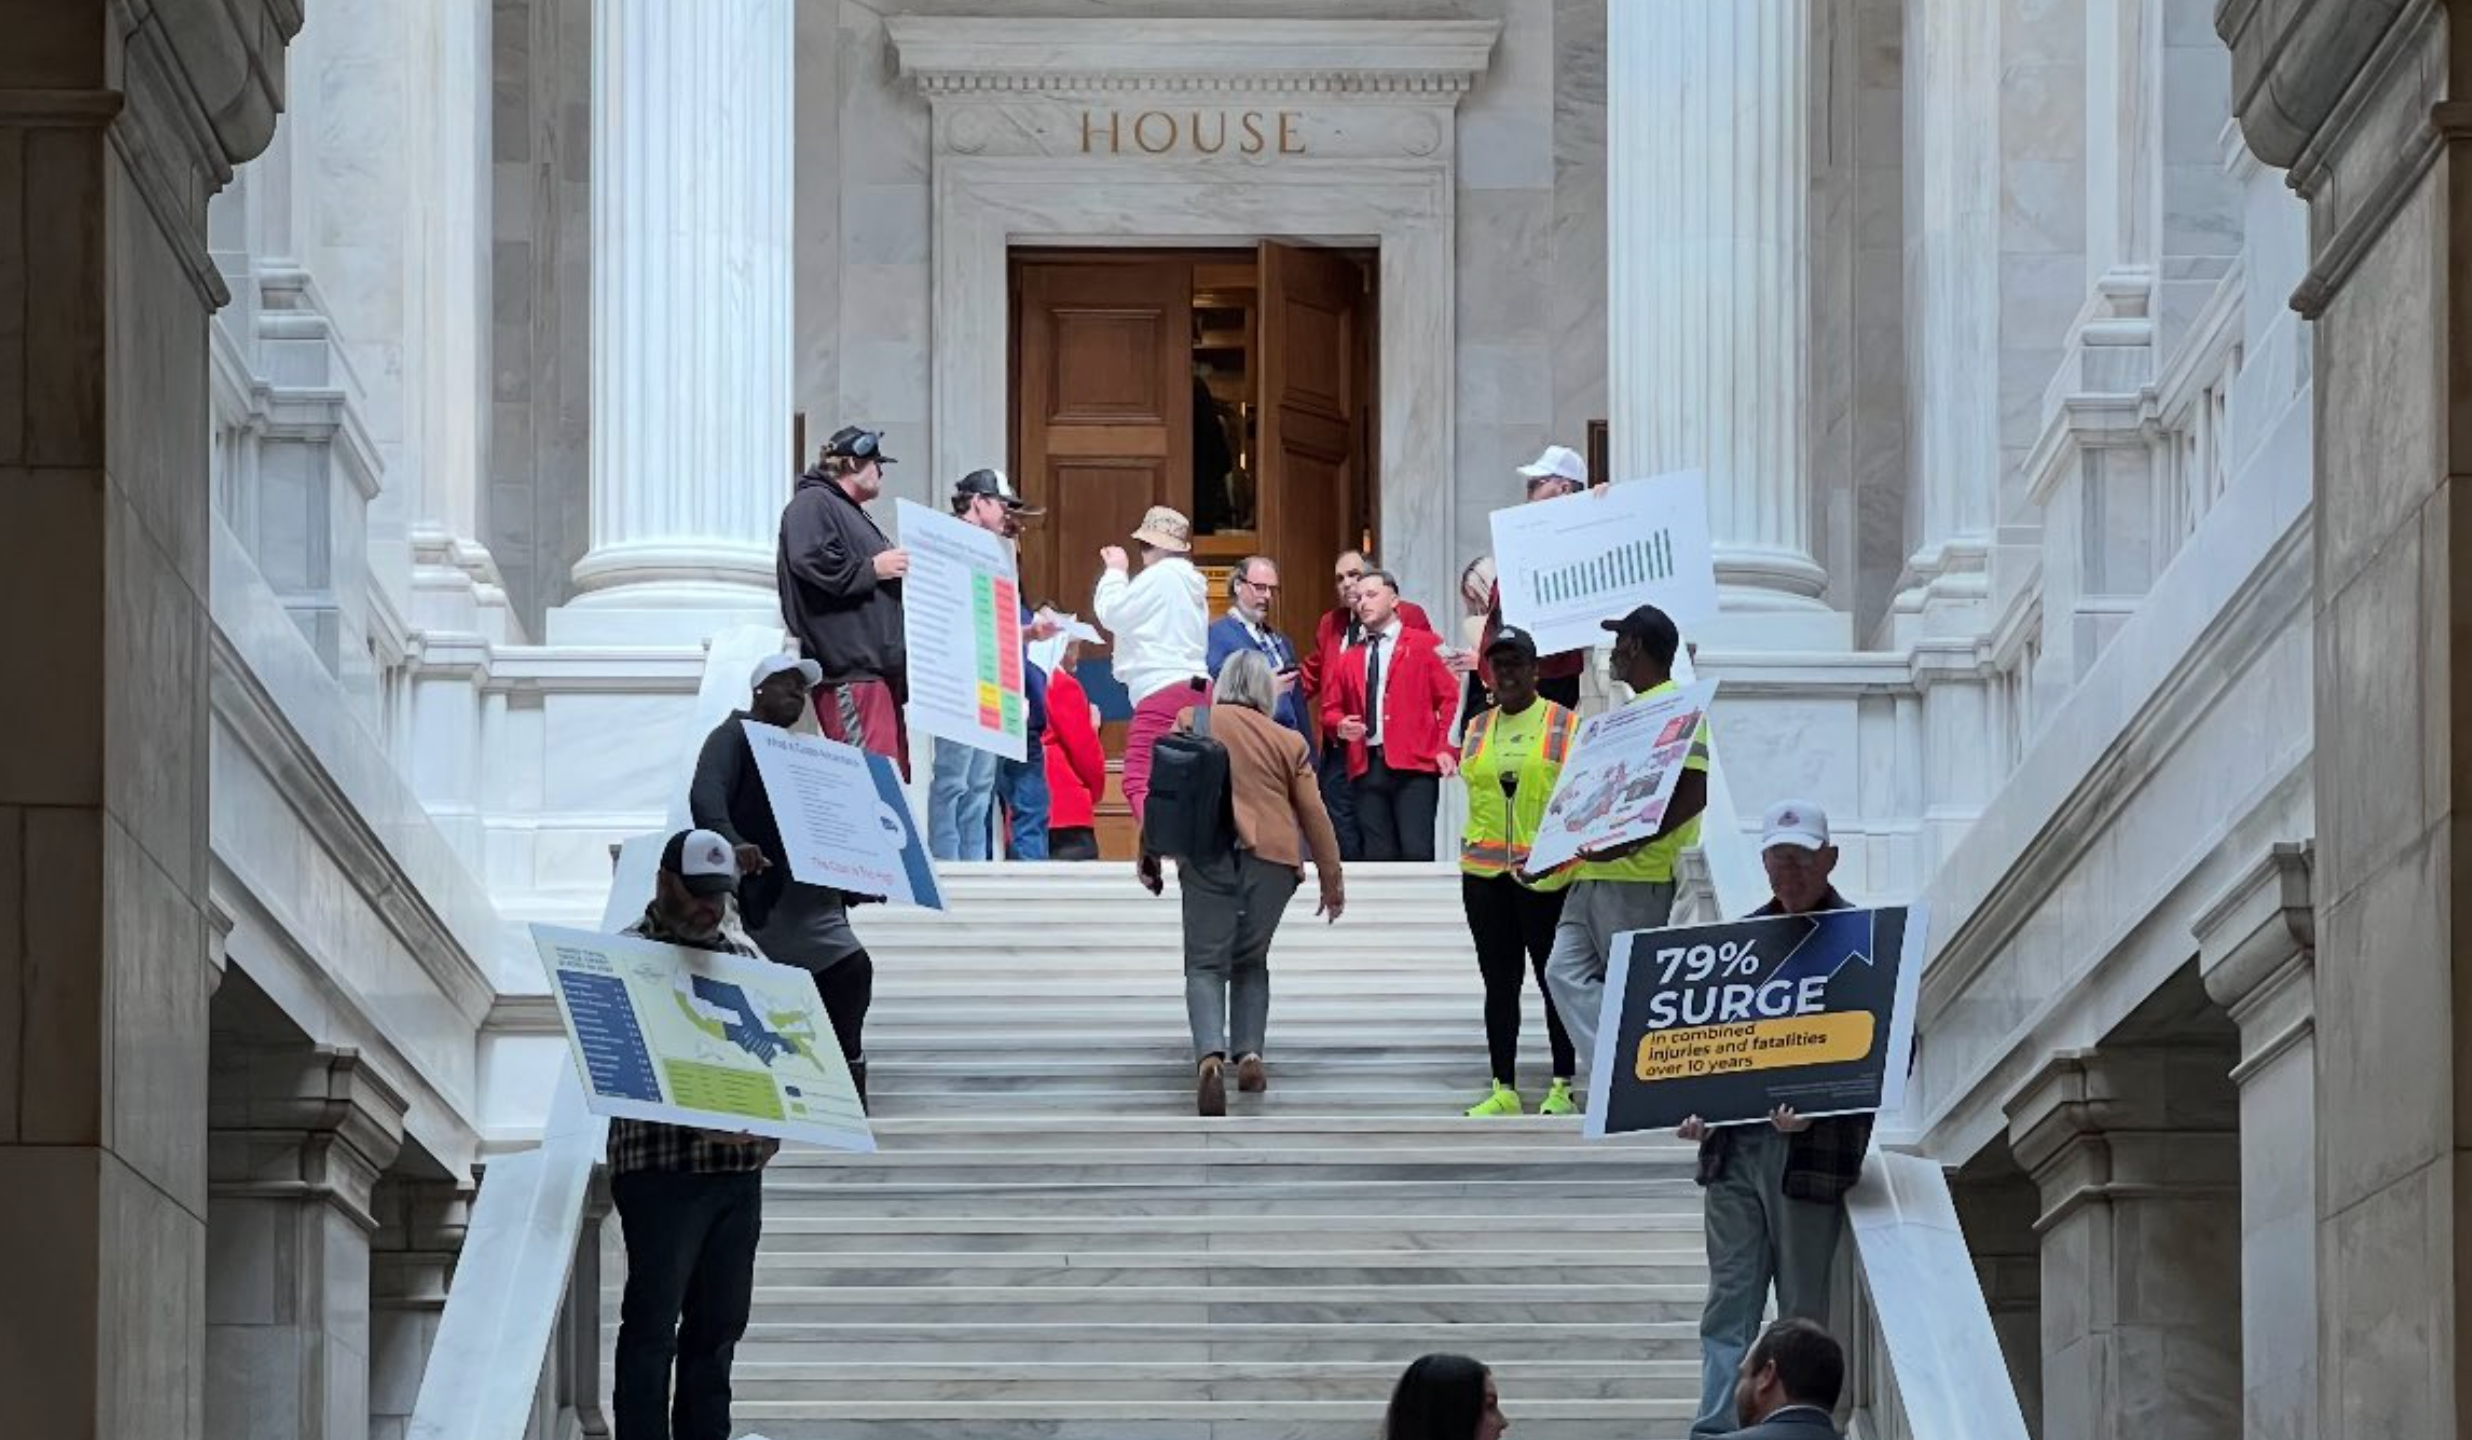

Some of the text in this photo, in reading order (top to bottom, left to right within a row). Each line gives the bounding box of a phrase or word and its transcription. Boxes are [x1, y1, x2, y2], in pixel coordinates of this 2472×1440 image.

[1081, 110, 1306, 154] HOUSE
[1656, 939, 1760, 985] 79%
[1646, 975, 1829, 1029] SURGE
[1648, 1032, 1827, 1063] injuries and fatalities
[1671, 1024, 1756, 1044] combined
[1645, 1056, 1754, 1077] over 10 years
